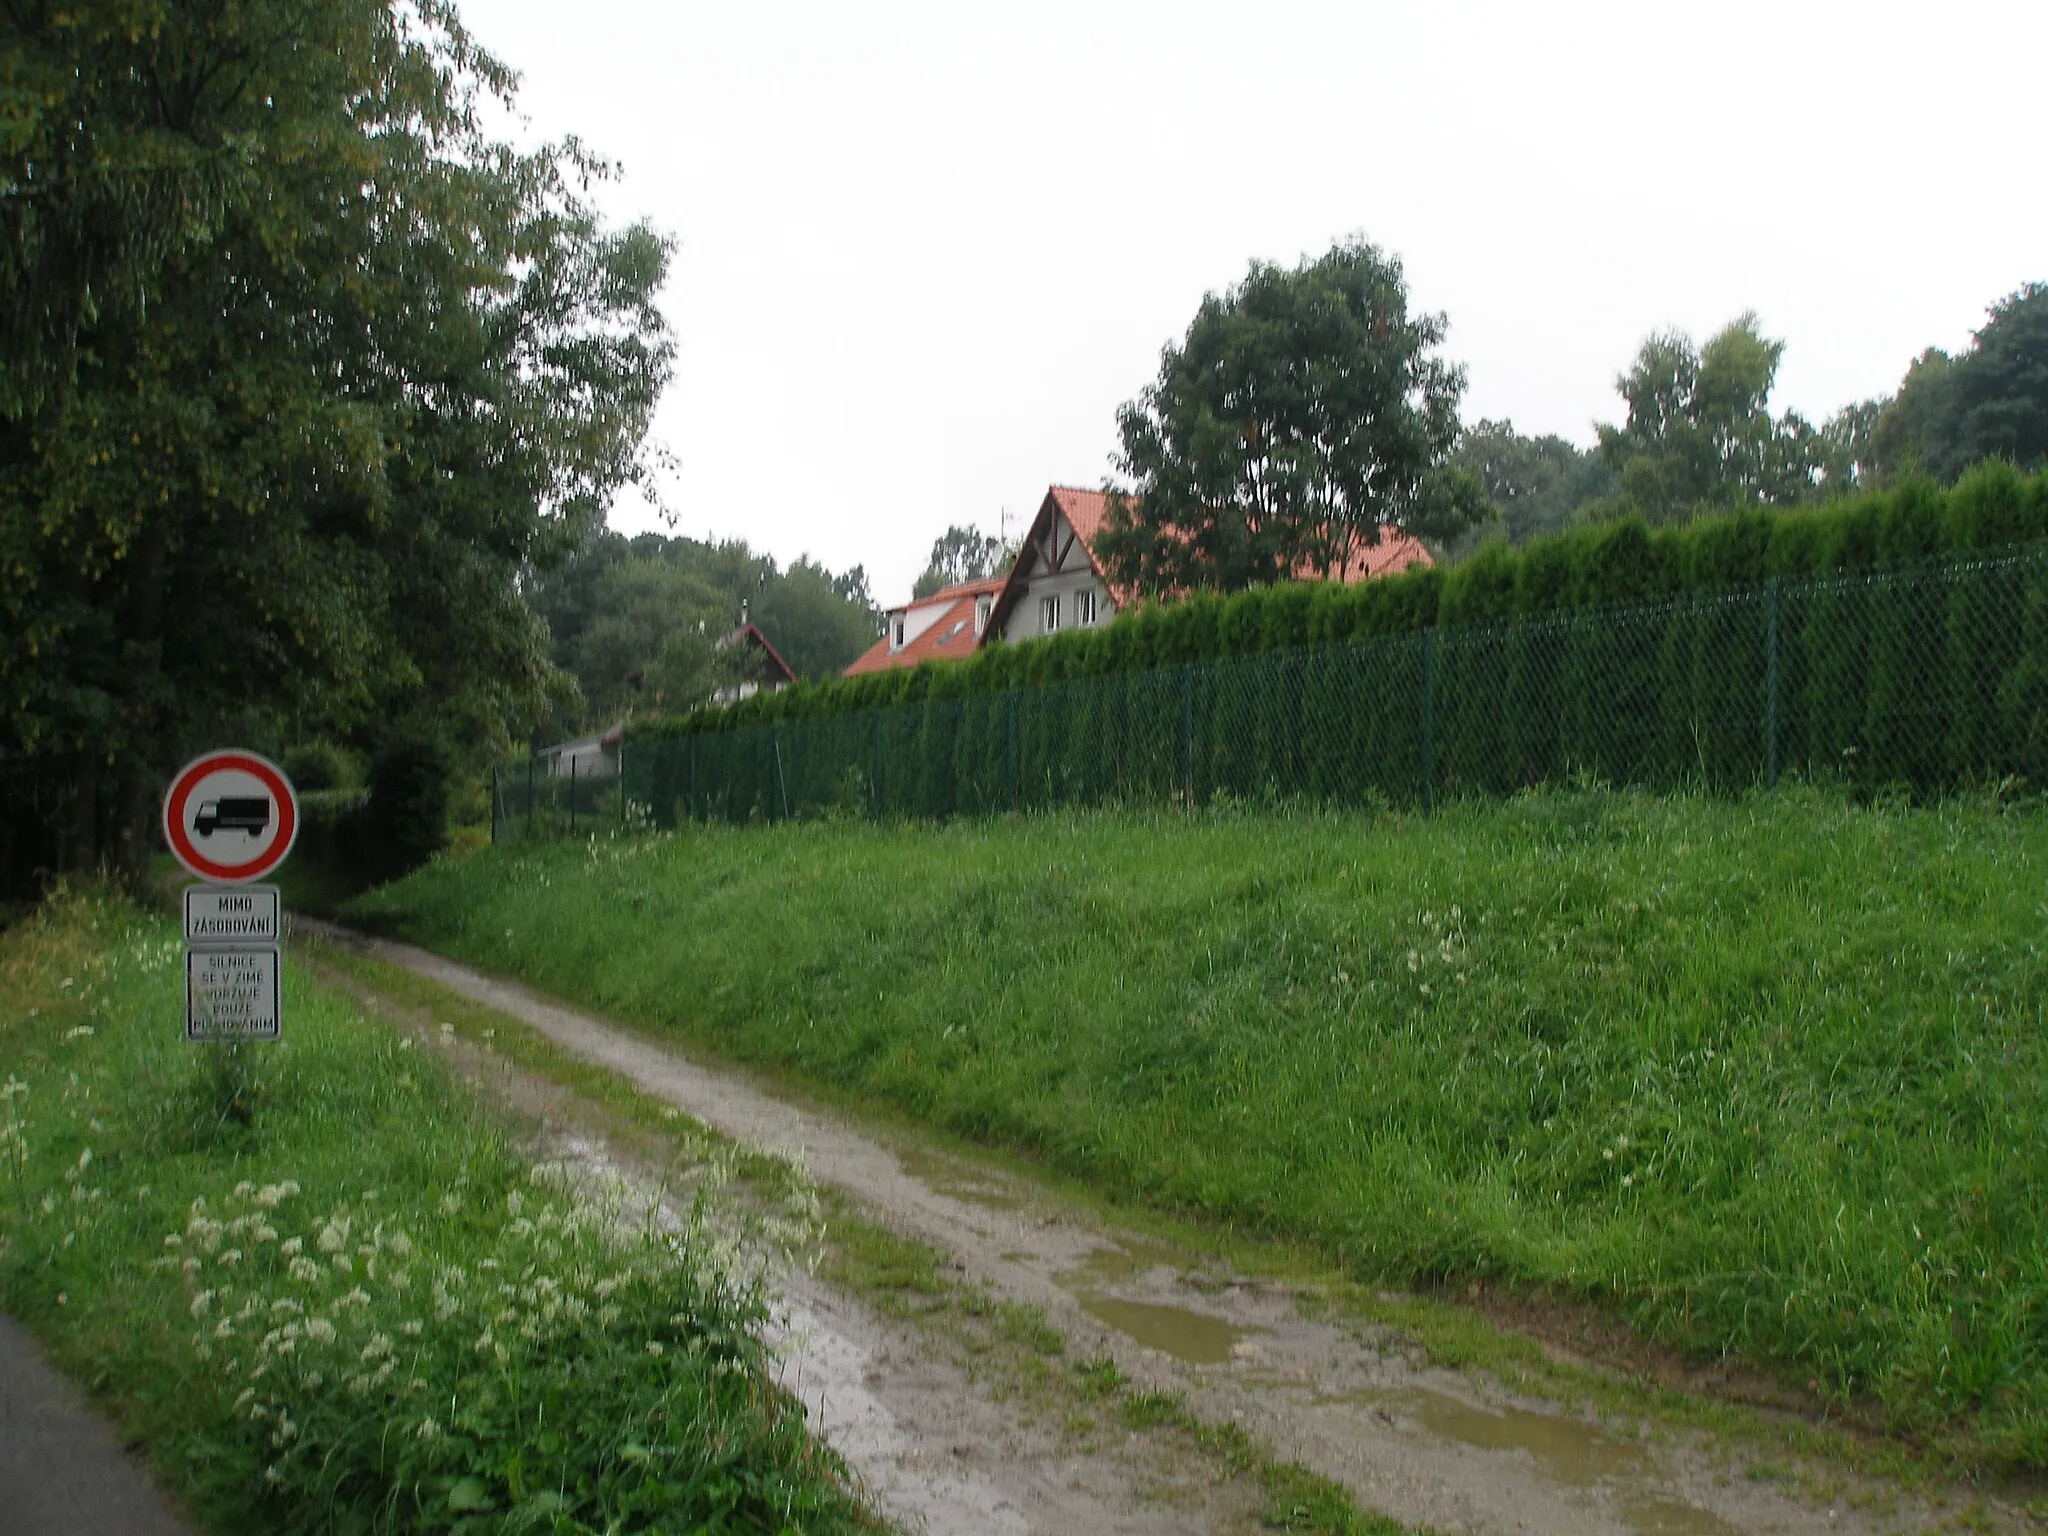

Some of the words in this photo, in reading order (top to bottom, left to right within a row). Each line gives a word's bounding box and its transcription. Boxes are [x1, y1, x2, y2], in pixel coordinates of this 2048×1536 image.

[219, 896, 252, 911] MIMO
[194, 915, 270, 933] ZÁSOBOVÁNÍ
[209, 956, 256, 968] SILNICE
[202, 971, 217, 984] SE
[222, 971, 230, 984] V
[193, 1017, 273, 1031] PLOÁNÍM
